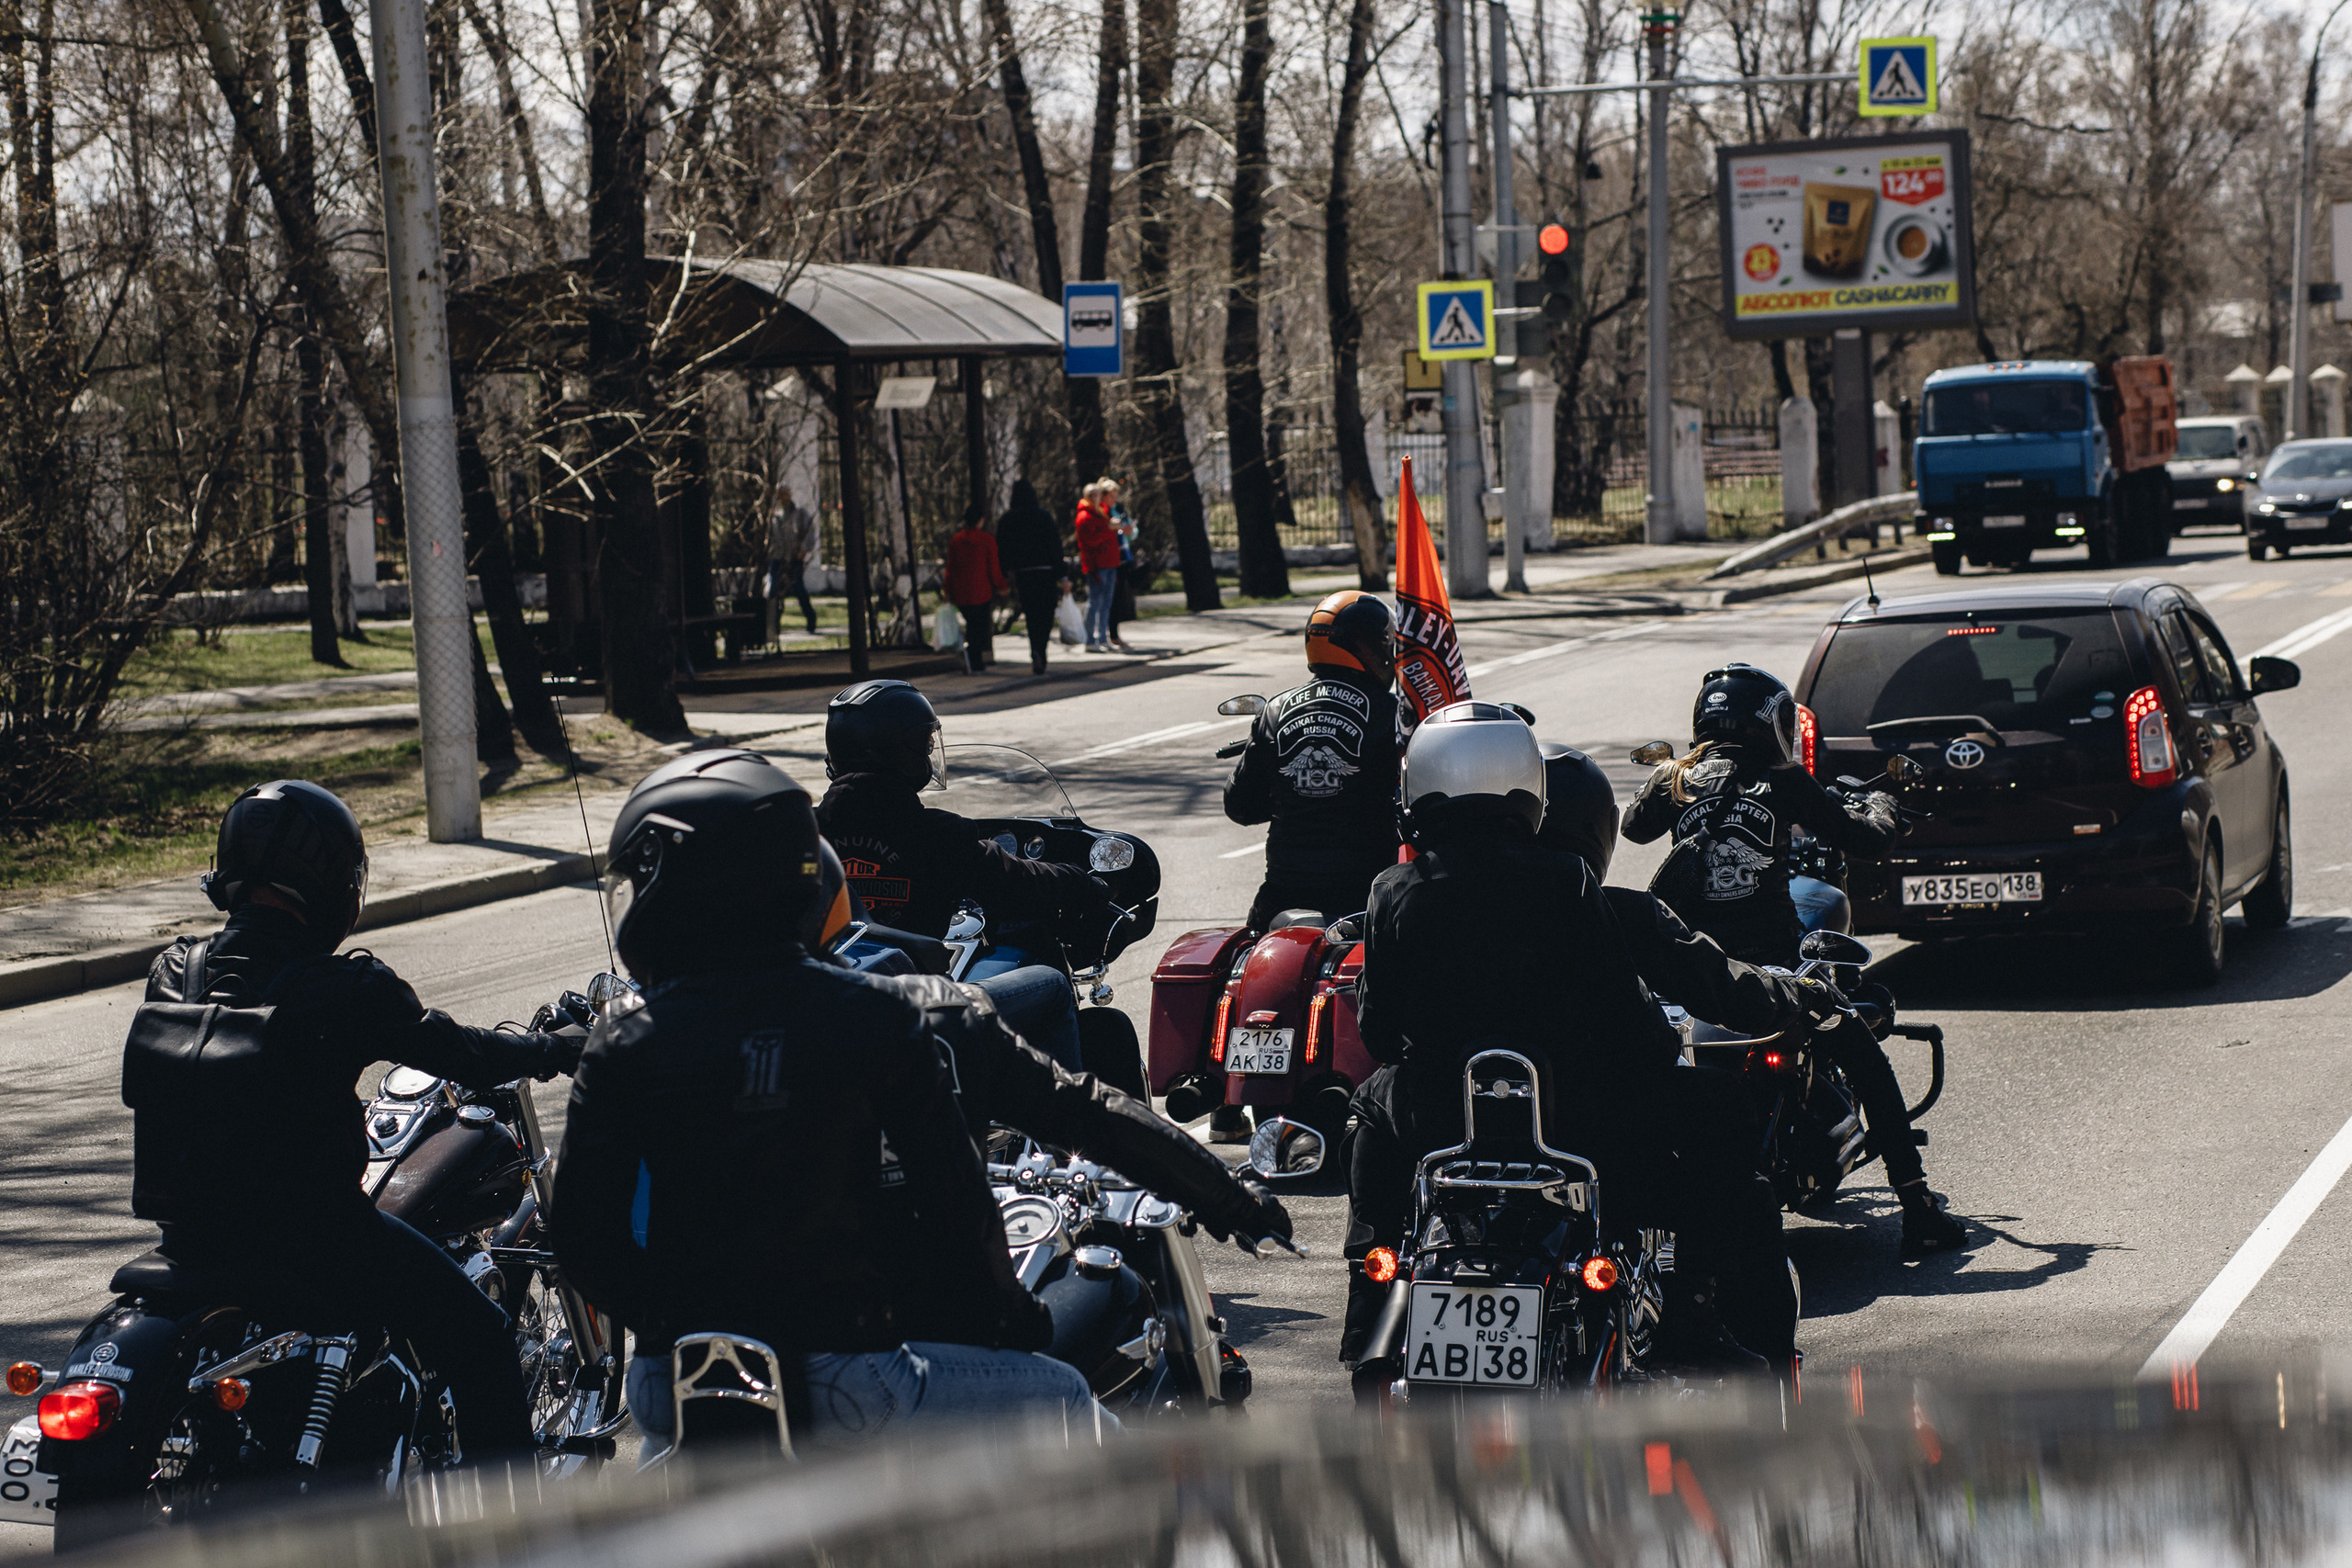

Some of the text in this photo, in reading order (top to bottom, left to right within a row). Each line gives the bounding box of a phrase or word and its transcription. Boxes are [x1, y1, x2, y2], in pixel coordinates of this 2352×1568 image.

[1884, 172, 1925, 196] 124
[1289, 685, 1364, 707] LIFE MEMBER
[1402, 660, 1446, 714] BAIKAL
[1283, 715, 1358, 738] BAIKAL CHAPTER
[1304, 726, 1337, 736] RUSSIA
[1680, 804, 1713, 831] BAIKAL
[833, 835, 900, 864] NUINE
[2003, 874, 2035, 892] 138
[1239, 1031, 1283, 1046] 2176
[1262, 1055, 1283, 1070] 38
[1430, 1292, 1521, 1328] 7189
[1476, 1329, 1509, 1343] RUS
[68, 1363, 131, 1381] HARLEY-DAVIDSON
[1484, 1345, 1528, 1380] 38
